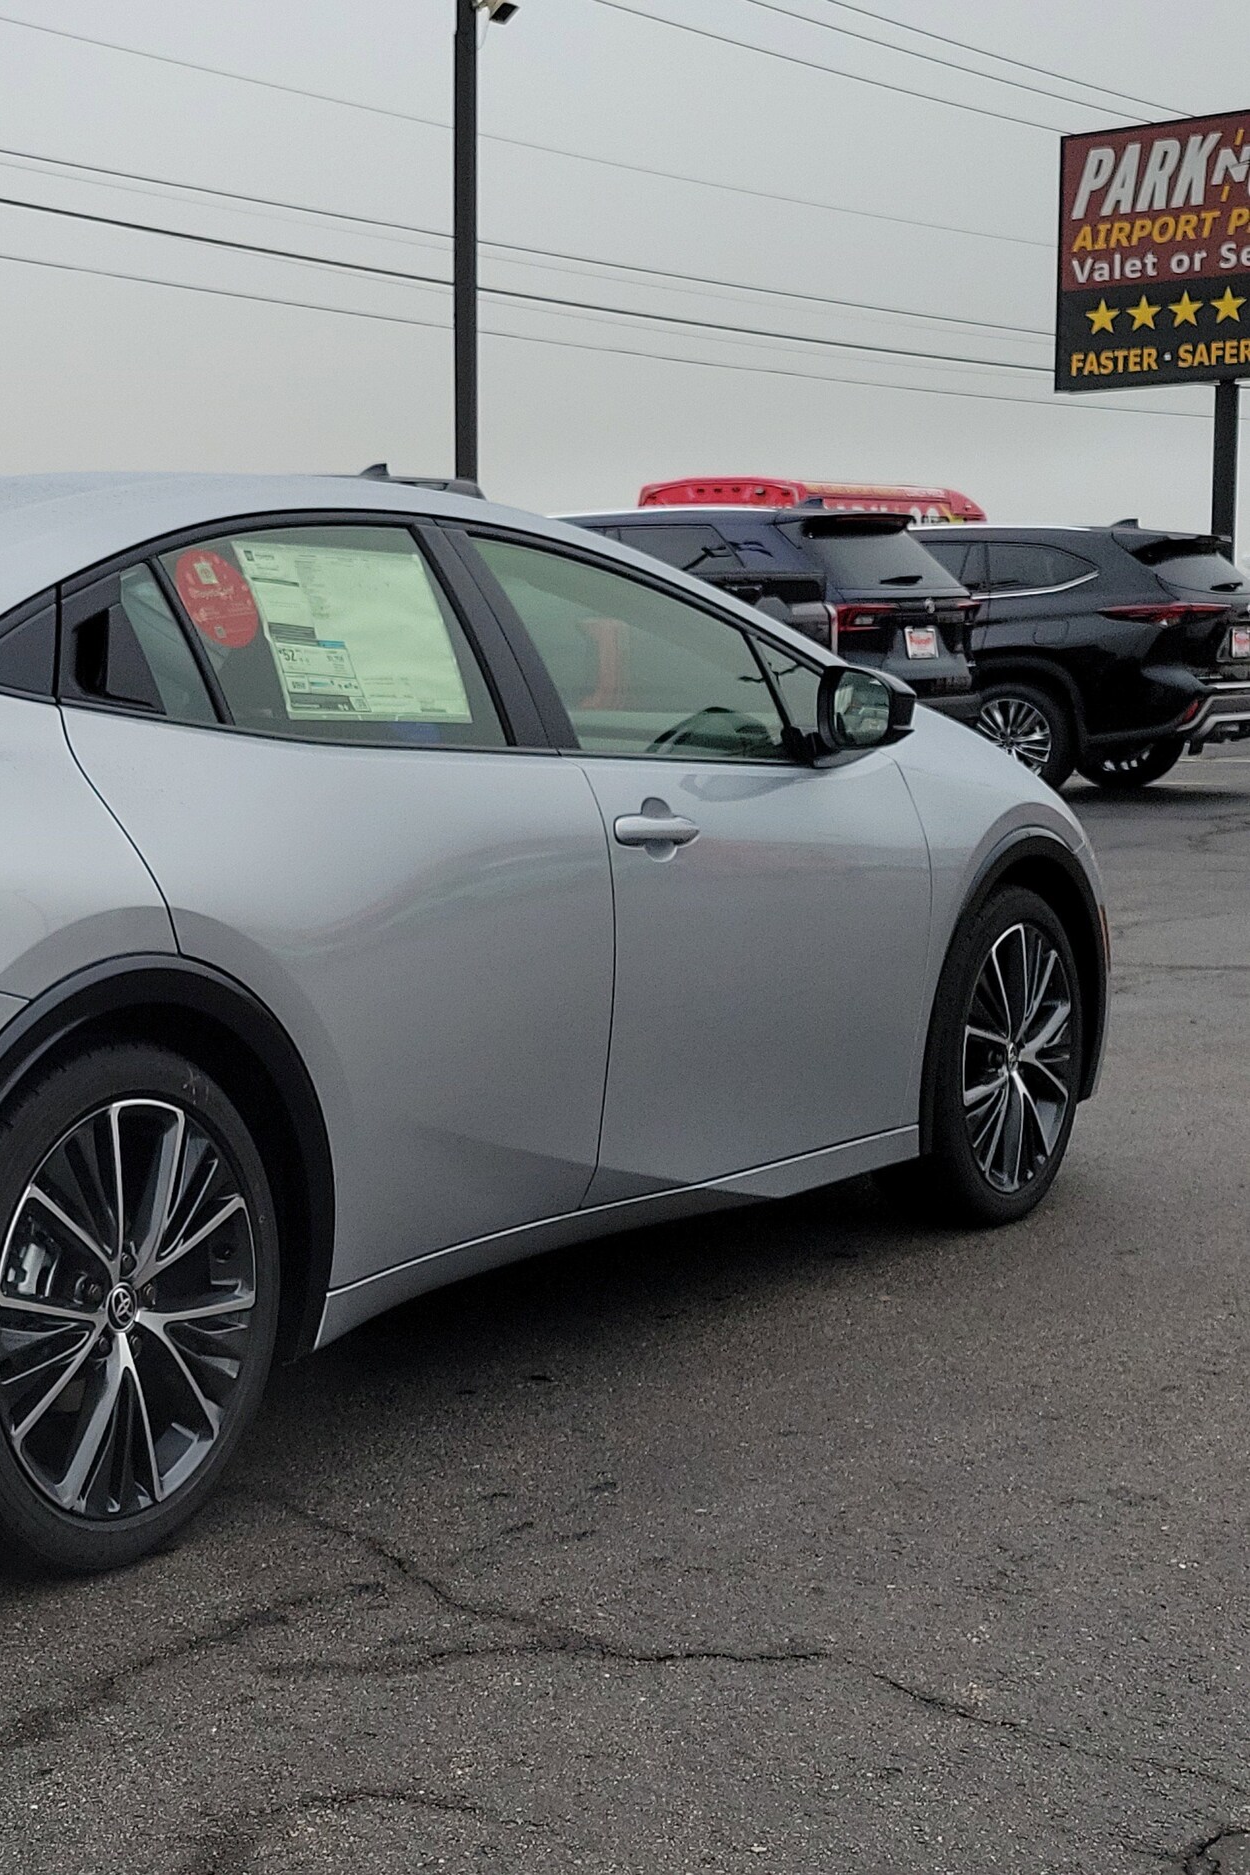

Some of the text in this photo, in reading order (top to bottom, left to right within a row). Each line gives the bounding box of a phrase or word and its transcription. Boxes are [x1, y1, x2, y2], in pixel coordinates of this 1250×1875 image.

[1071, 133, 1222, 220] PARK
[1072, 206, 1250, 252] AIRPORT P
[1071, 251, 1158, 284] Valet
[1170, 250, 1208, 275] or
[1070, 338, 1250, 377] FASTER SAFER
